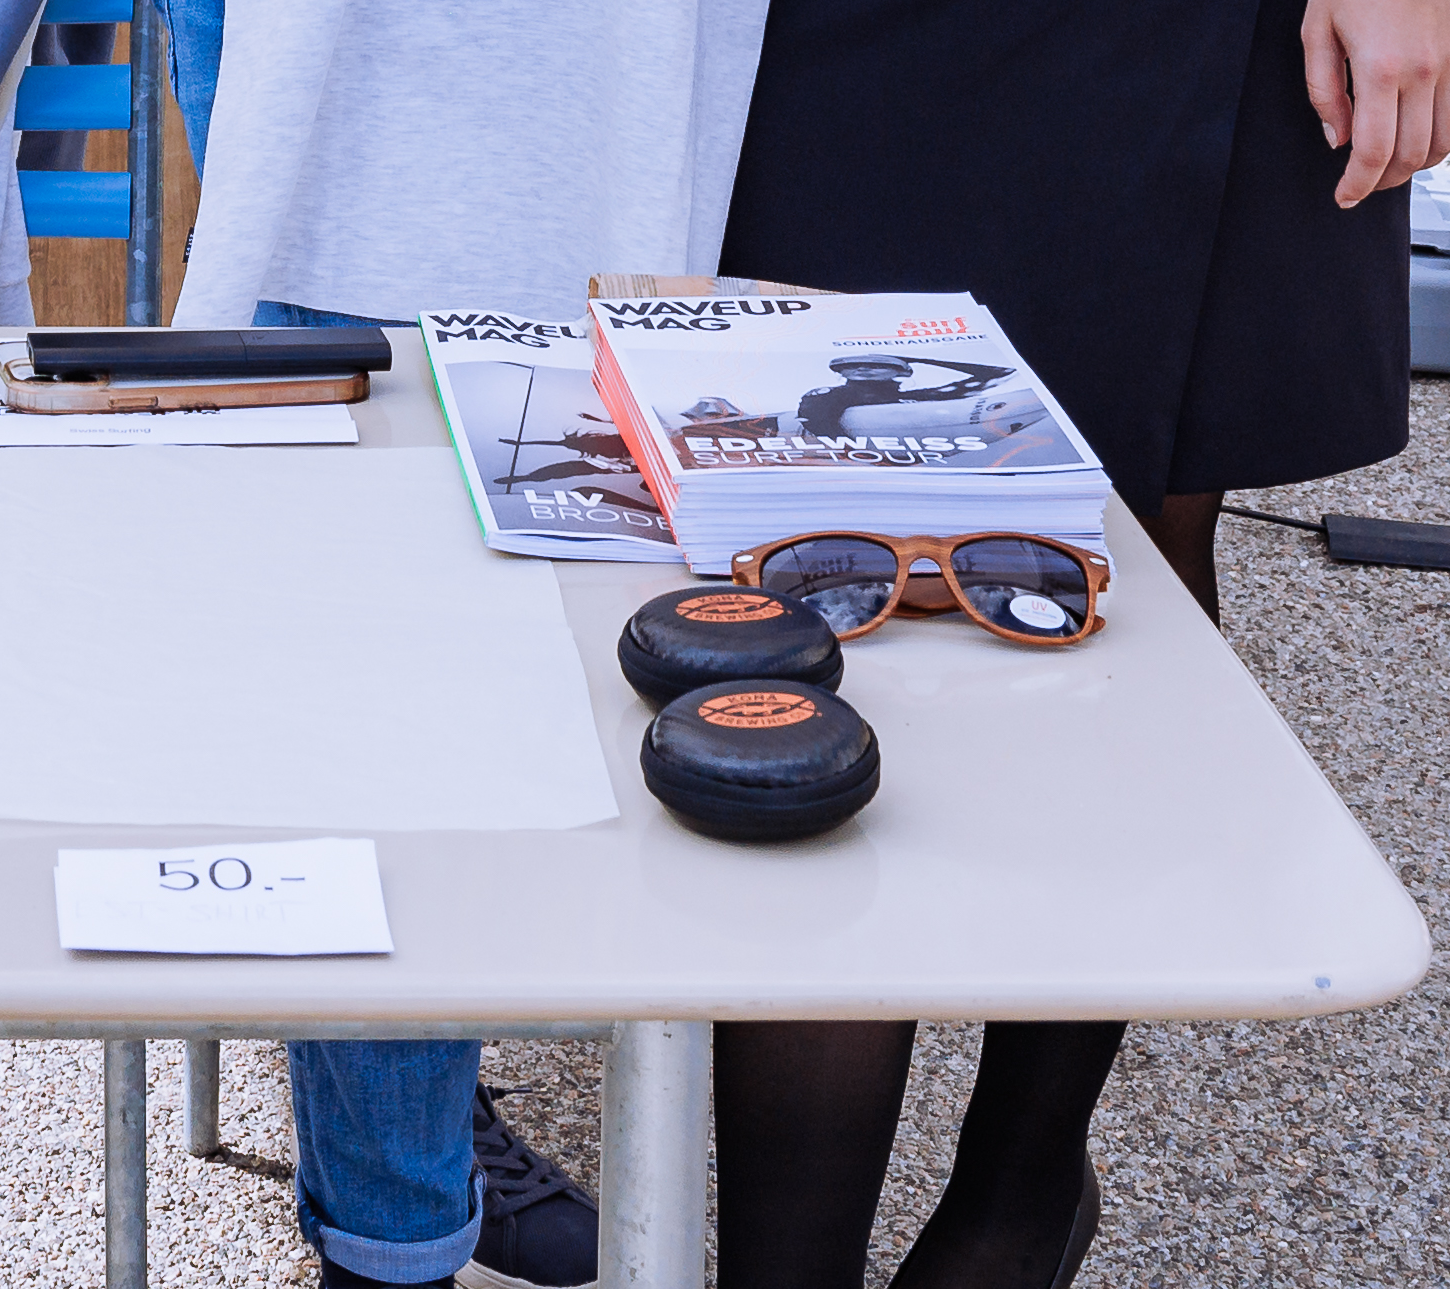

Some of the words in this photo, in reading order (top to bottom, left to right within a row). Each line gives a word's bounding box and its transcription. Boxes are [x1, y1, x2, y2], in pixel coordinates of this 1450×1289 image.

[600, 299, 812, 317] WAVEUP
[611, 316, 732, 332] MAG
[434, 327, 551, 349] MAG
[831, 333, 990, 348] SONDERAUSGABE
[684, 436, 989, 453] EDELWEISS
[694, 450, 808, 466] SURF
[815, 450, 949, 465] TOUR
[522, 488, 604, 508] LIV
[157, 857, 306, 892] 50.-
